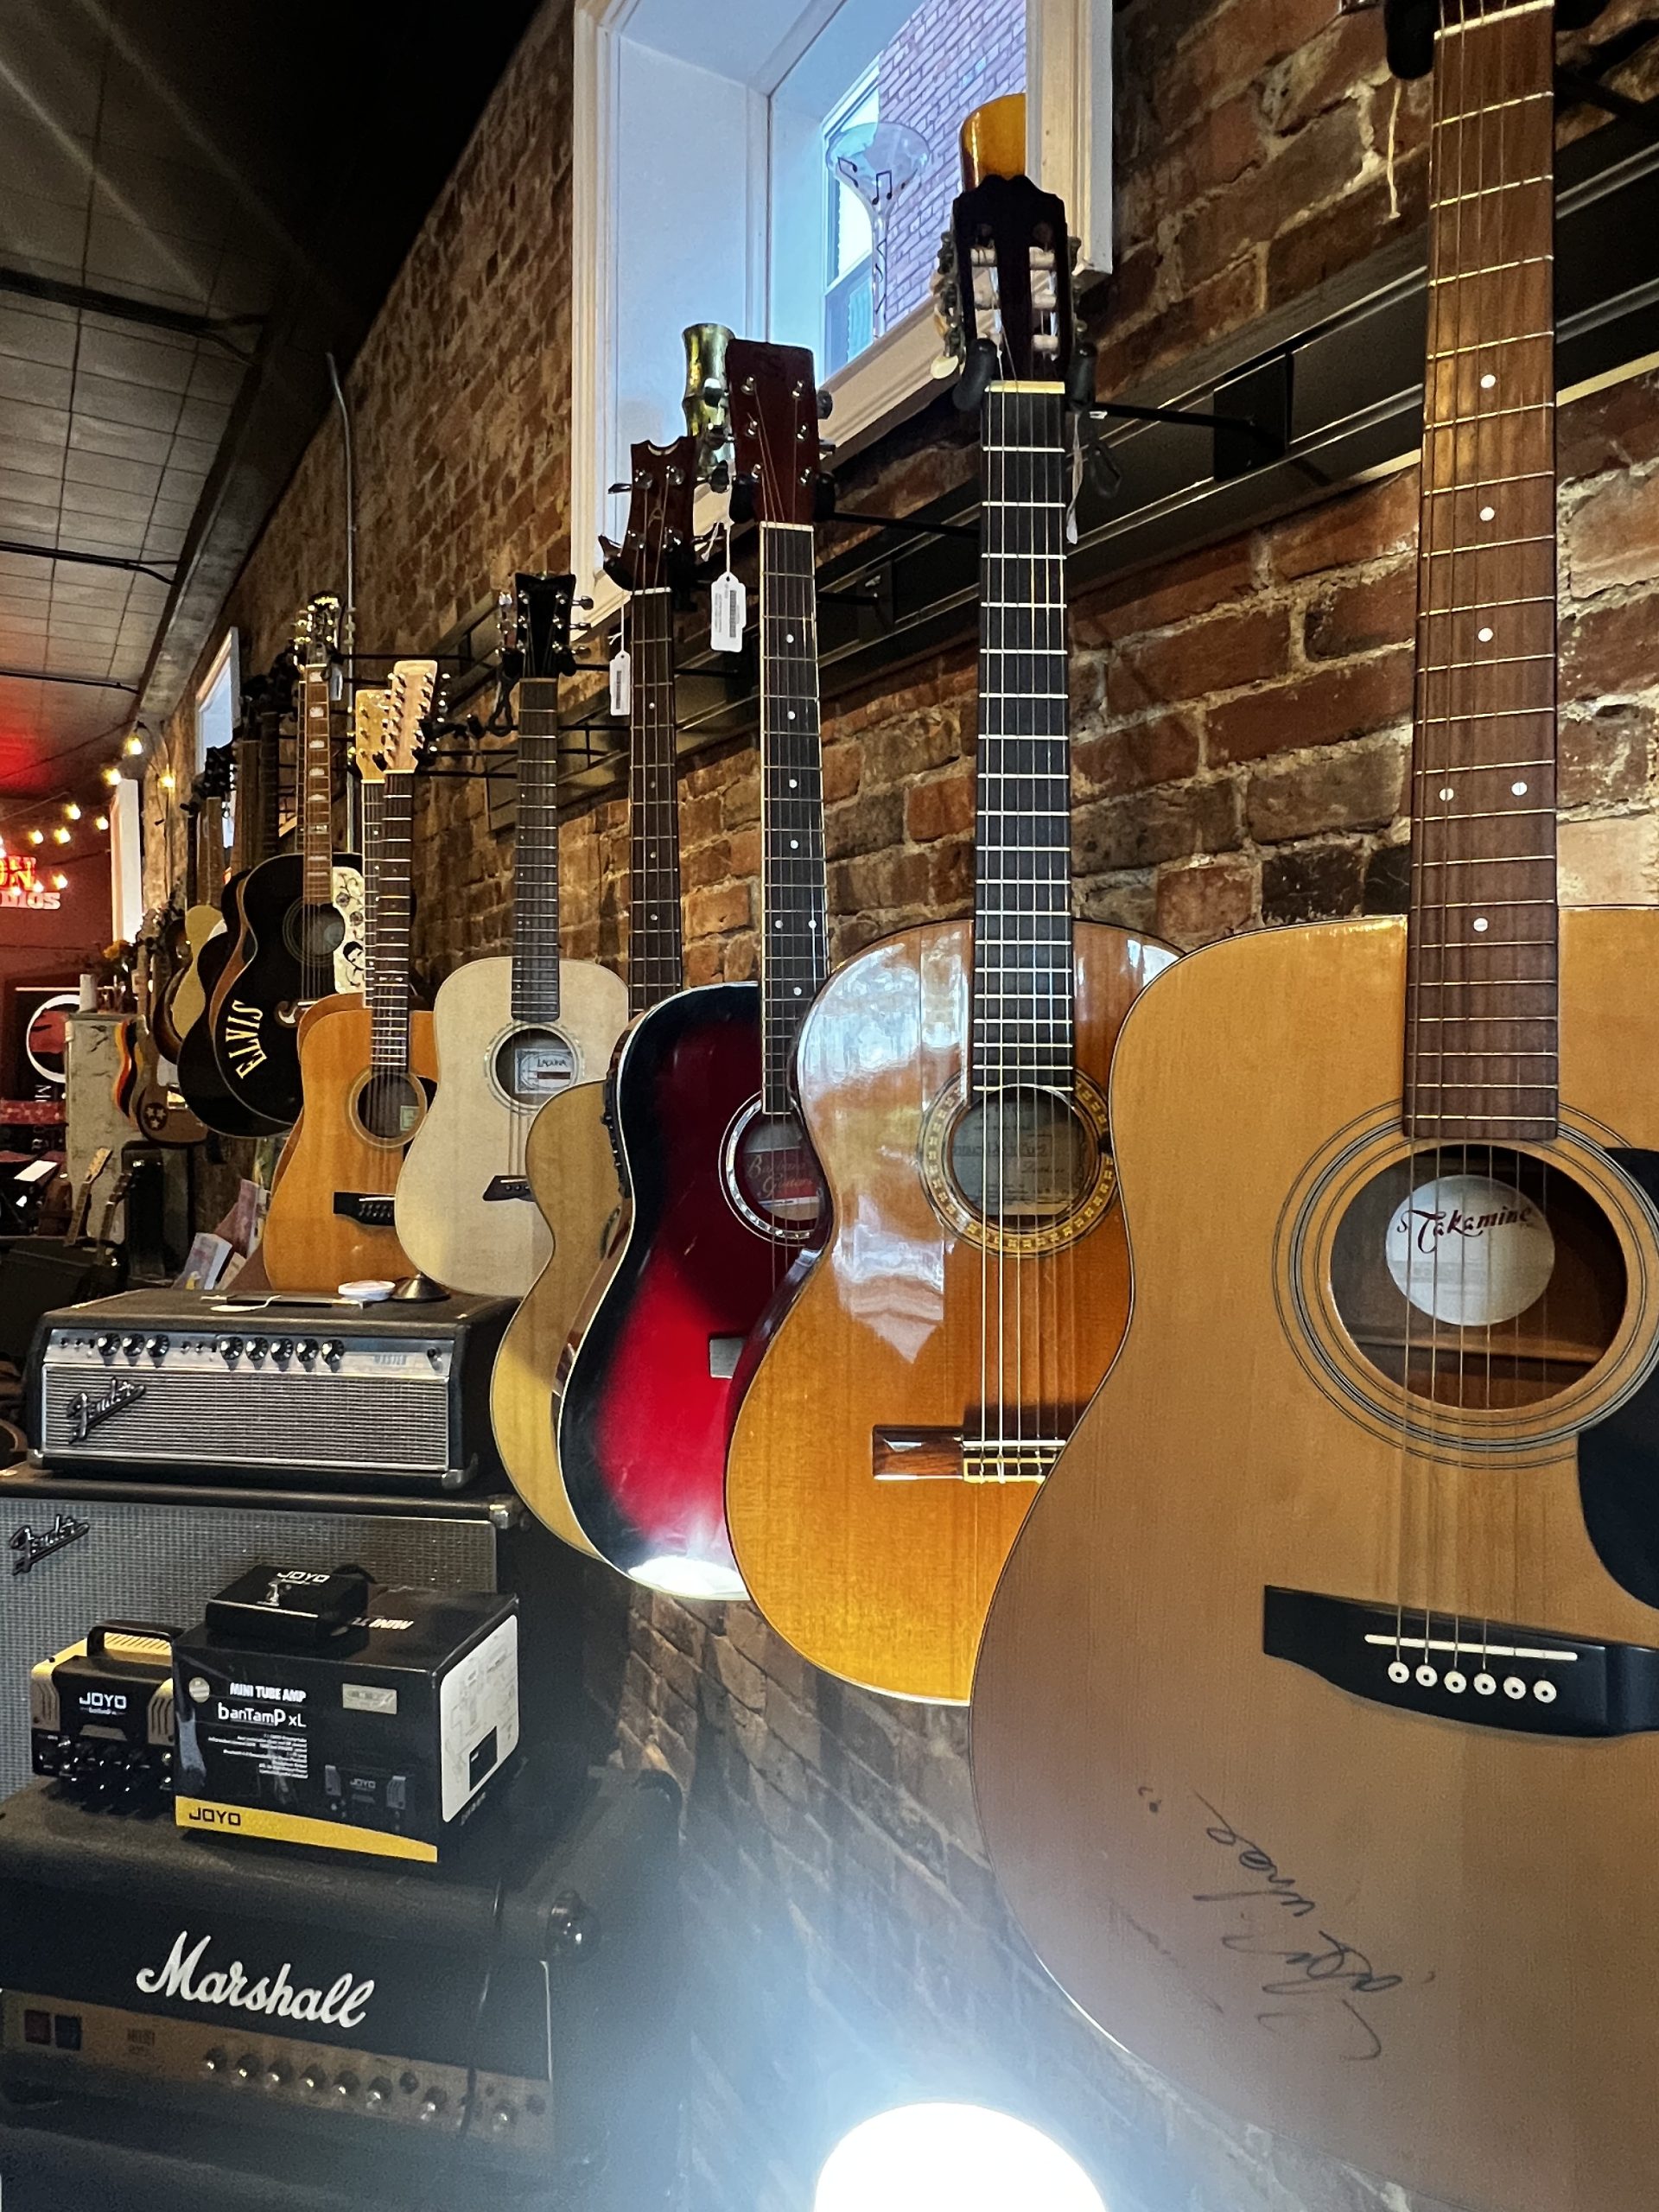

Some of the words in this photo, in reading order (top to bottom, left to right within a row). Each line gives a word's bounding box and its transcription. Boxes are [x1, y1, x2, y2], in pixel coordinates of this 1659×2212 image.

[226, 1000, 267, 1079] ELVIS
[1396, 1206, 1531, 1254] Takamine
[67, 1376, 146, 1446] Fender
[10, 1514, 90, 1576] Fender
[276, 1570, 331, 1583] JOYO
[79, 1692, 127, 1709] JOYO
[229, 1682, 254, 1697] MINI
[255, 1686, 282, 1700] TUBE
[282, 1688, 307, 1703] AMP
[188, 1807, 241, 1827] JOYO
[136, 1930, 375, 2029] Marshall
